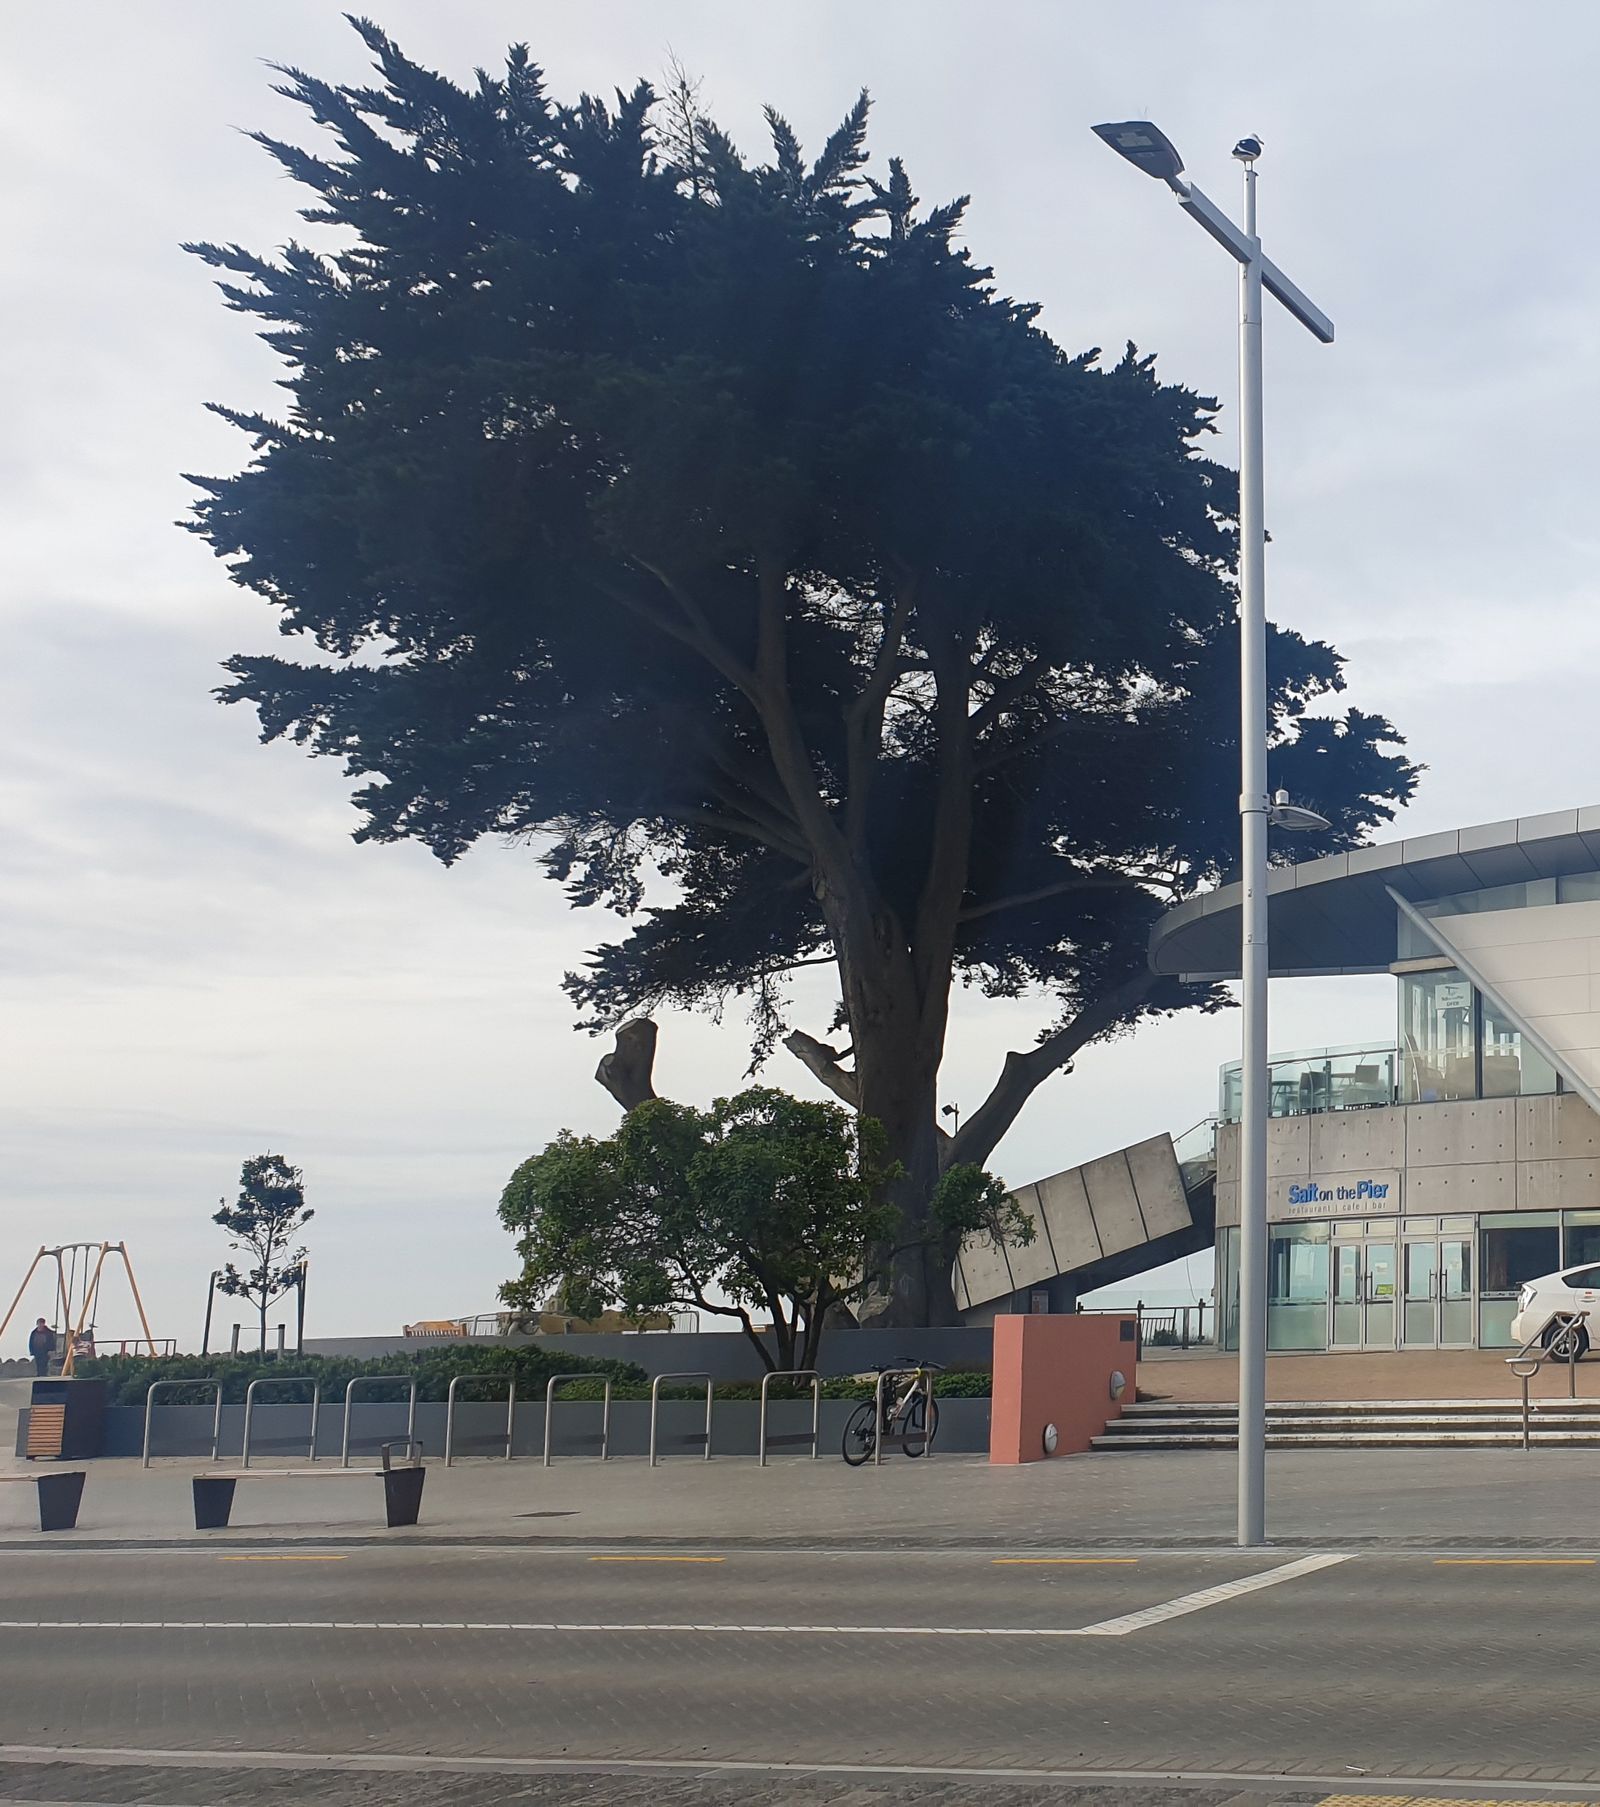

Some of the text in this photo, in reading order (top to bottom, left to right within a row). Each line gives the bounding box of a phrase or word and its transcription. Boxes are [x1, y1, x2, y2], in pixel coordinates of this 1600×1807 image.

[1288, 1180, 1389, 1204] Salt on the Pier
[1288, 1204, 1331, 1214] restaurant
[1343, 1202, 1360, 1212] cafe
[1372, 1200, 1386, 1210] bar
